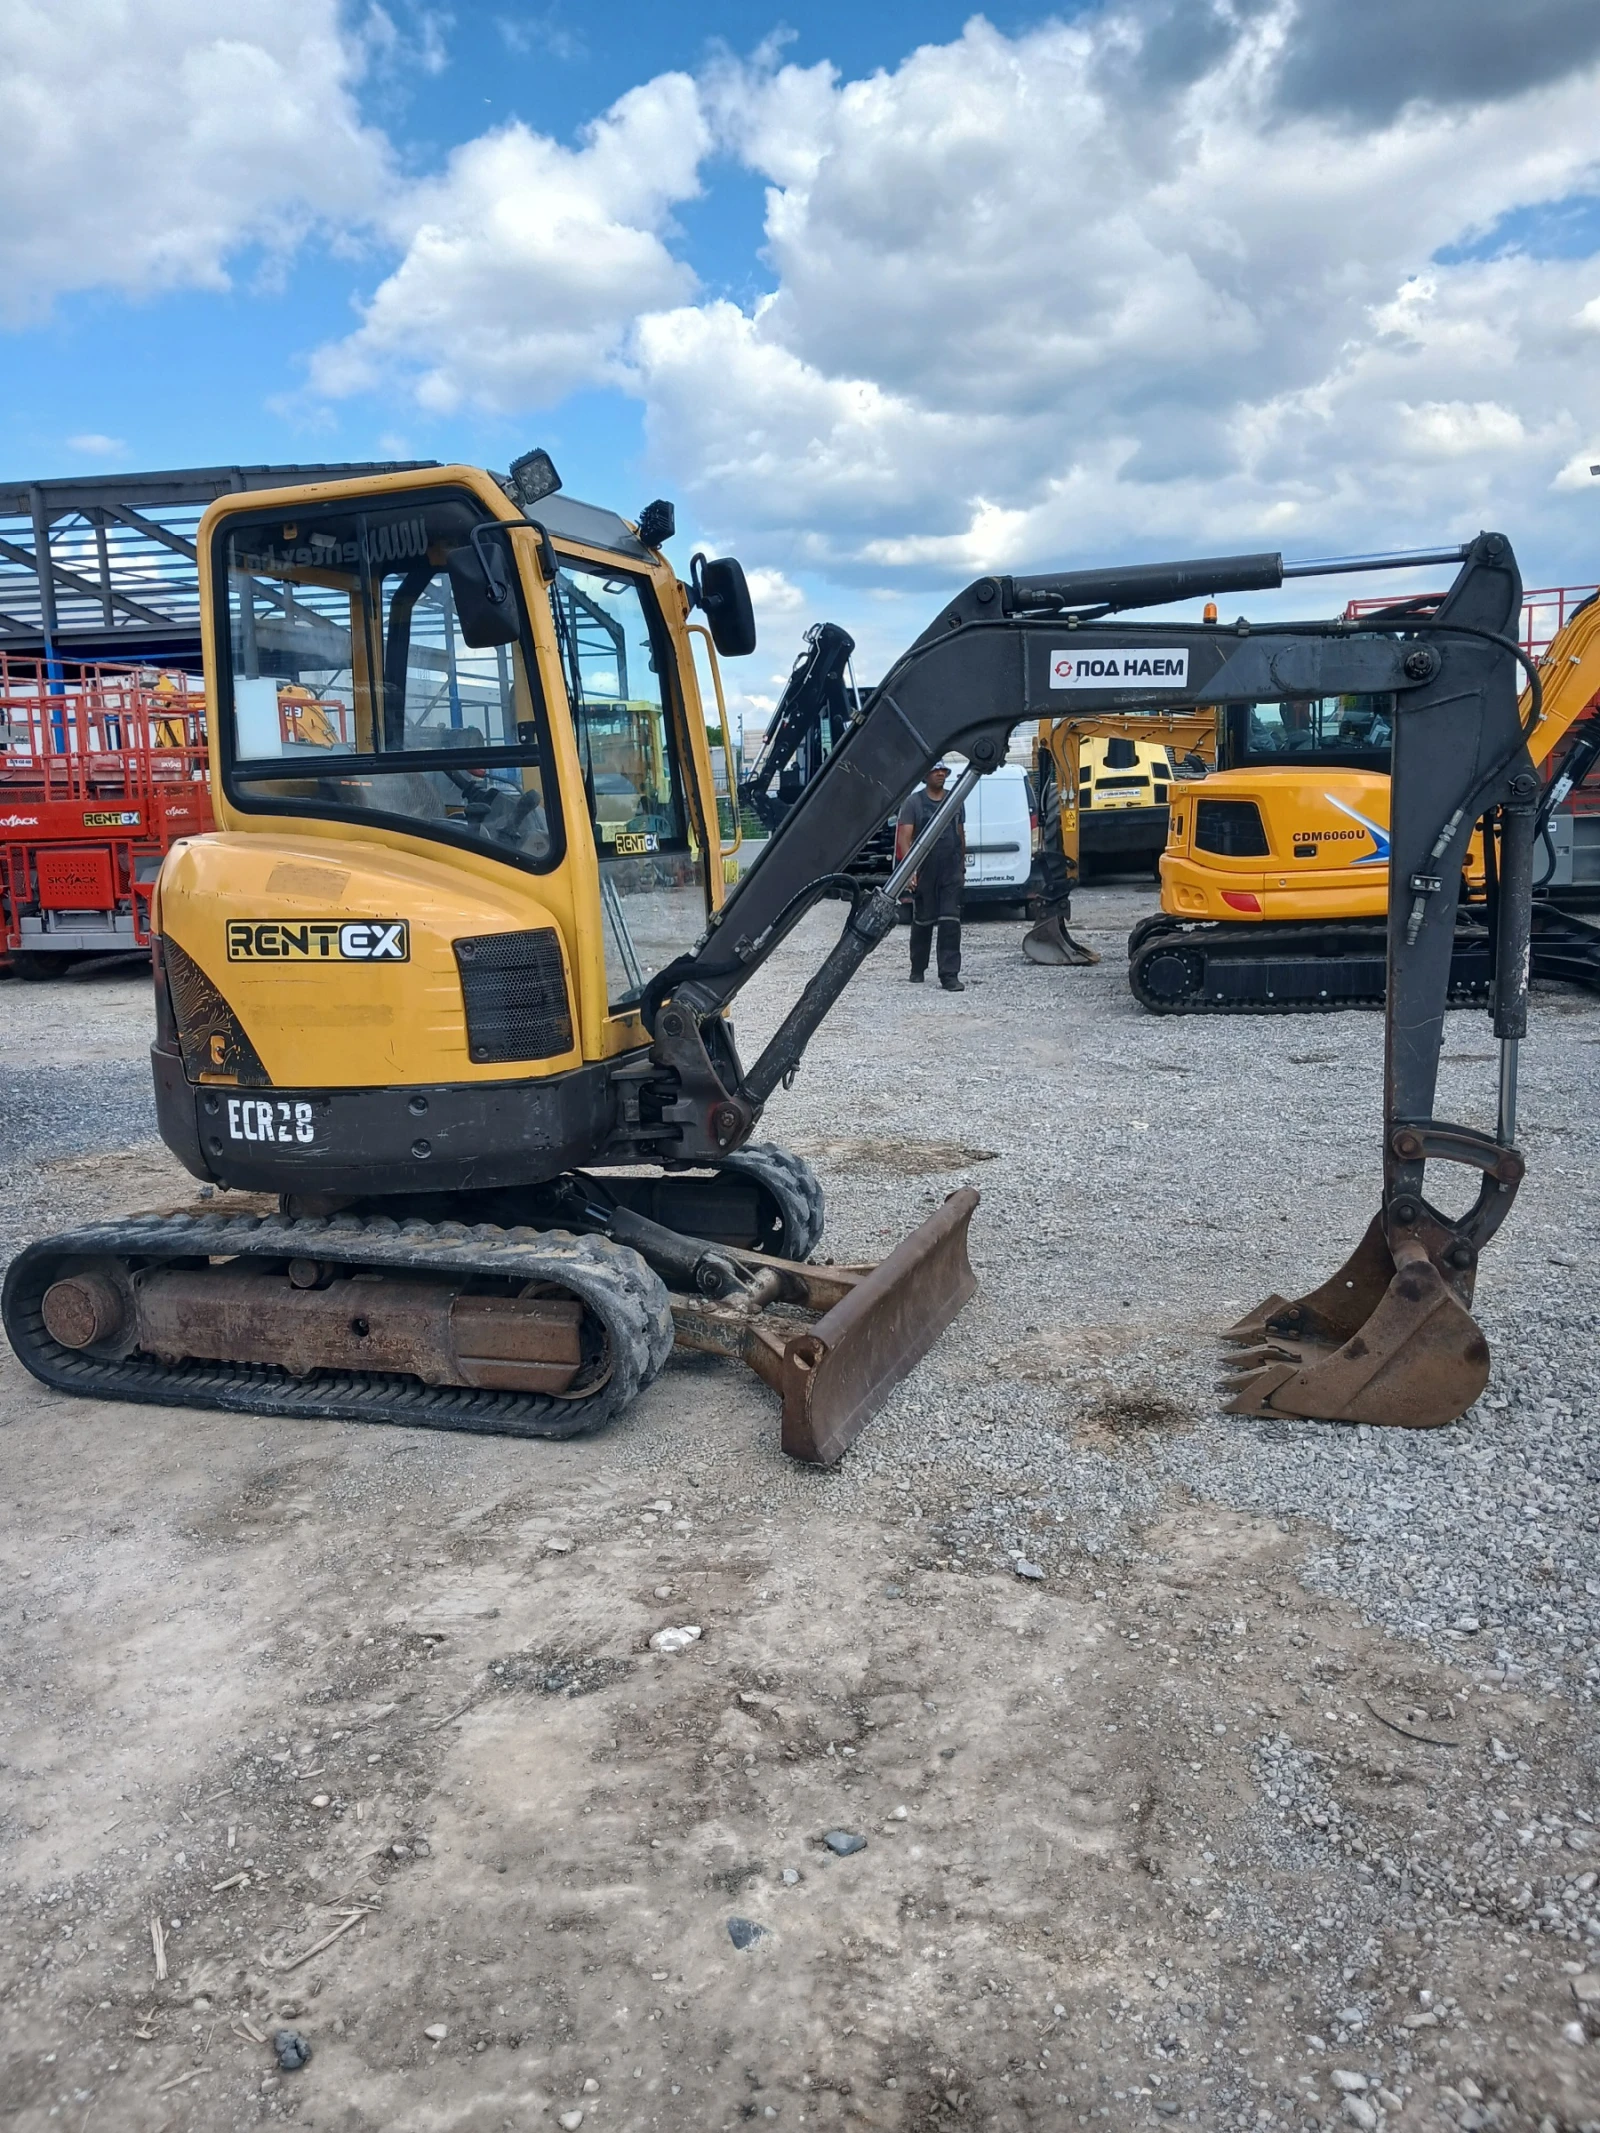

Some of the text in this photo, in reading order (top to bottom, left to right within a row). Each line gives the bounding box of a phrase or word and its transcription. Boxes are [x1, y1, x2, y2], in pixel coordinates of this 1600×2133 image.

[1076, 659, 1184, 677] ПОД НАЕМ
[85, 812, 140, 825] RENTEX
[616, 834, 659, 852] RENTEX
[1292, 830, 1366, 842] CDM6060U
[48, 873, 98, 886] SKYJACK
[230, 925, 402, 957] RENTEX
[228, 1099, 315, 1143] ECR28
